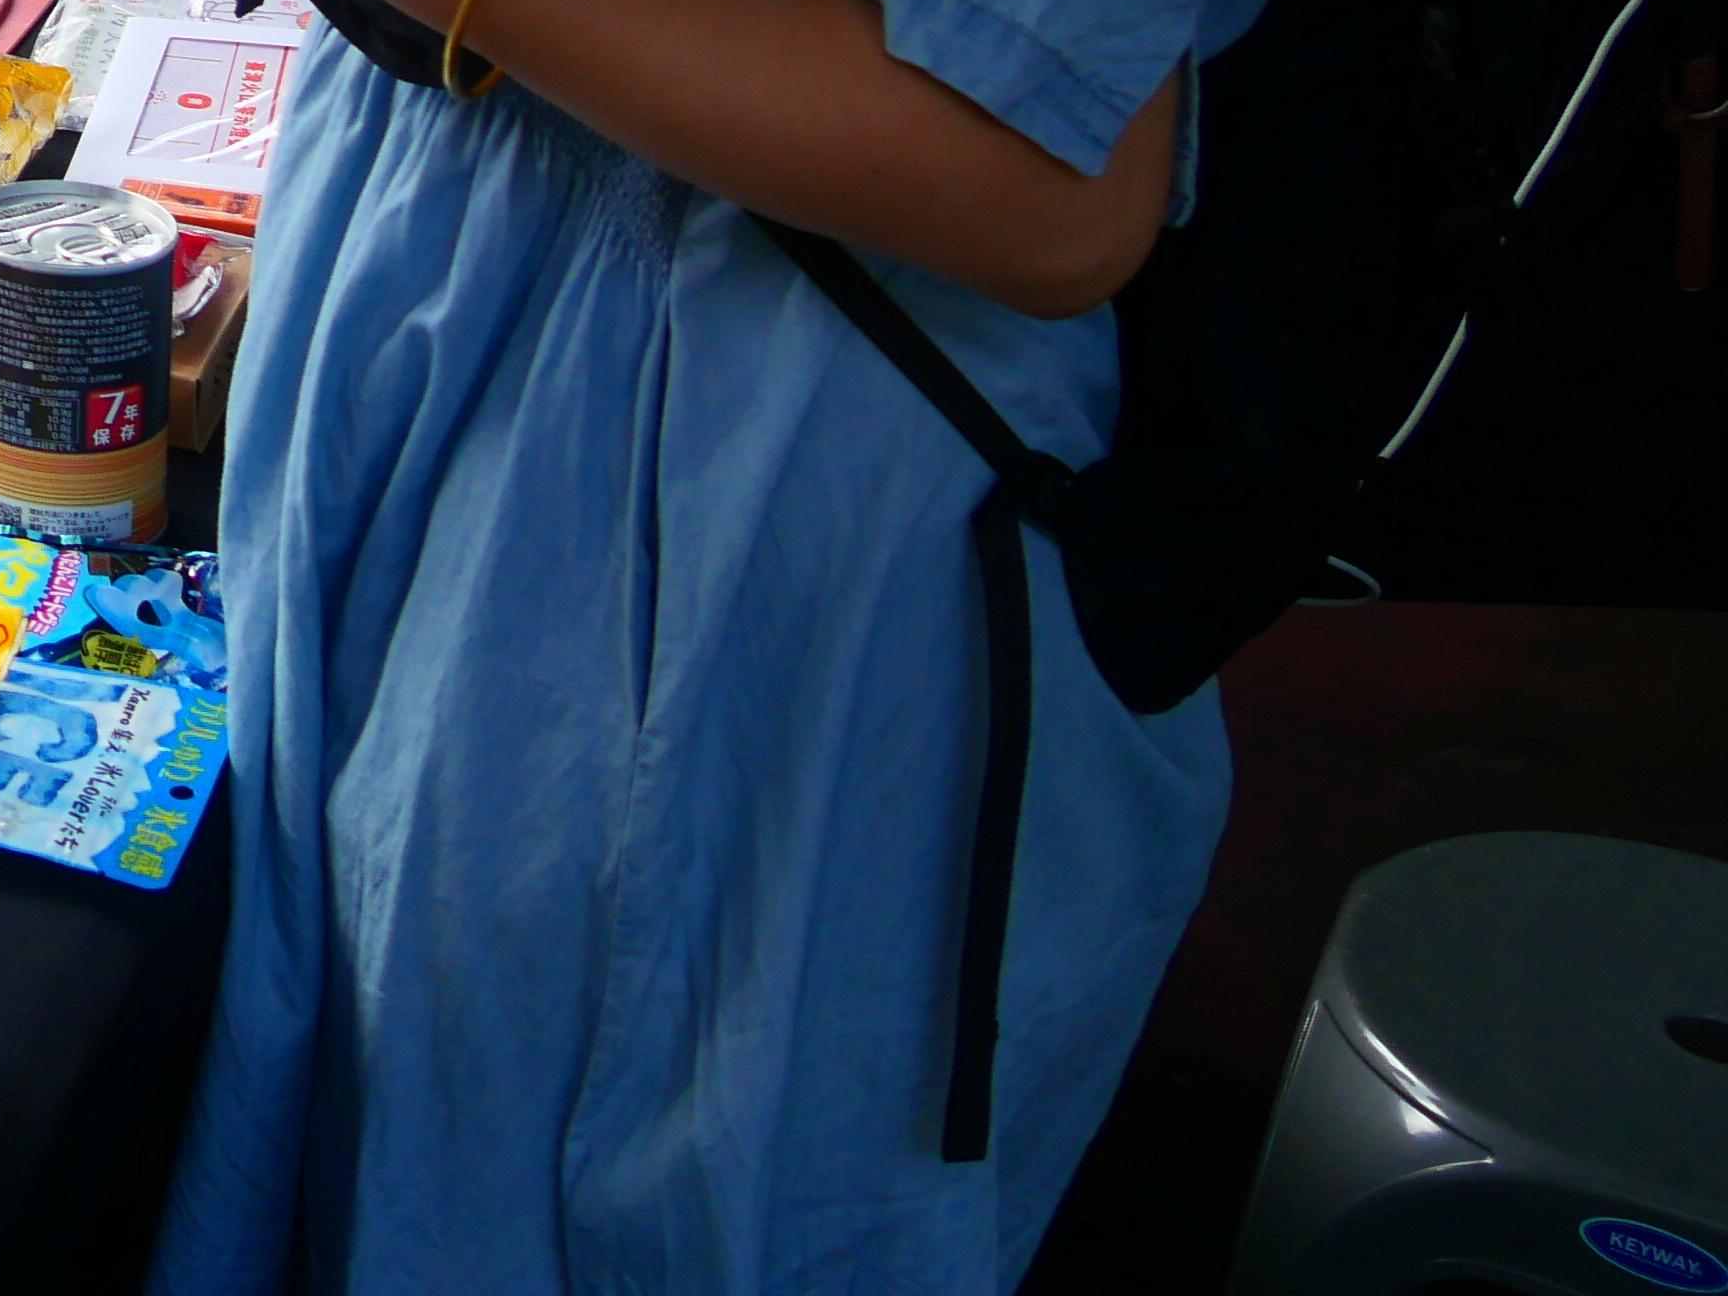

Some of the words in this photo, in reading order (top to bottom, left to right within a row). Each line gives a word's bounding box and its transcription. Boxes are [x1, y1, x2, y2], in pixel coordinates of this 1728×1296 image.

[92, 423, 137, 447] 保存
[120, 686, 152, 729] Kanro
[1608, 1229, 1703, 1277] KEYWAY
